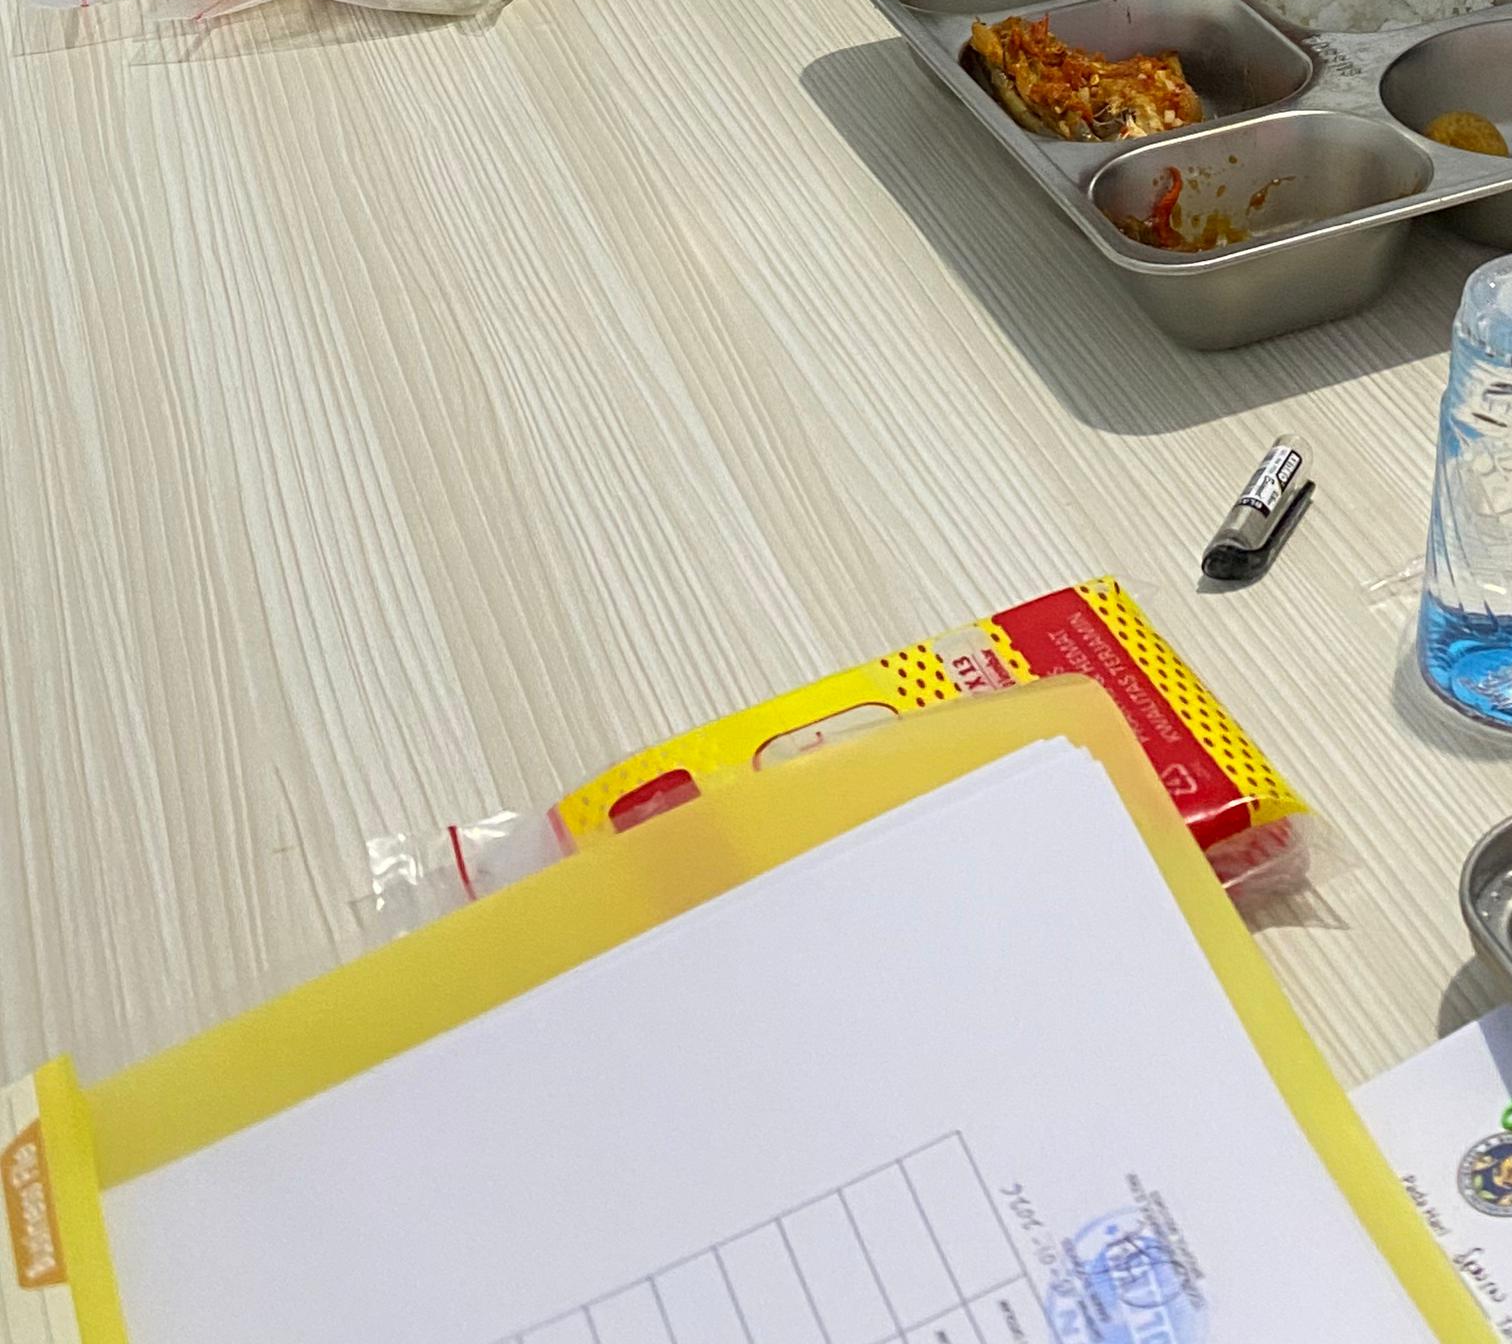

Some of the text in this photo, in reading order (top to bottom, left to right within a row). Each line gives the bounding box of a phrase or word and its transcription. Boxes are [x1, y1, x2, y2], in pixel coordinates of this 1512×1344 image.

[1048, 630, 1093, 673] HEMAT
[1068, 611, 1125, 677] TERJAMIN
[952, 655, 987, 690] X 13
[1118, 675, 1182, 743] KWALITAS
